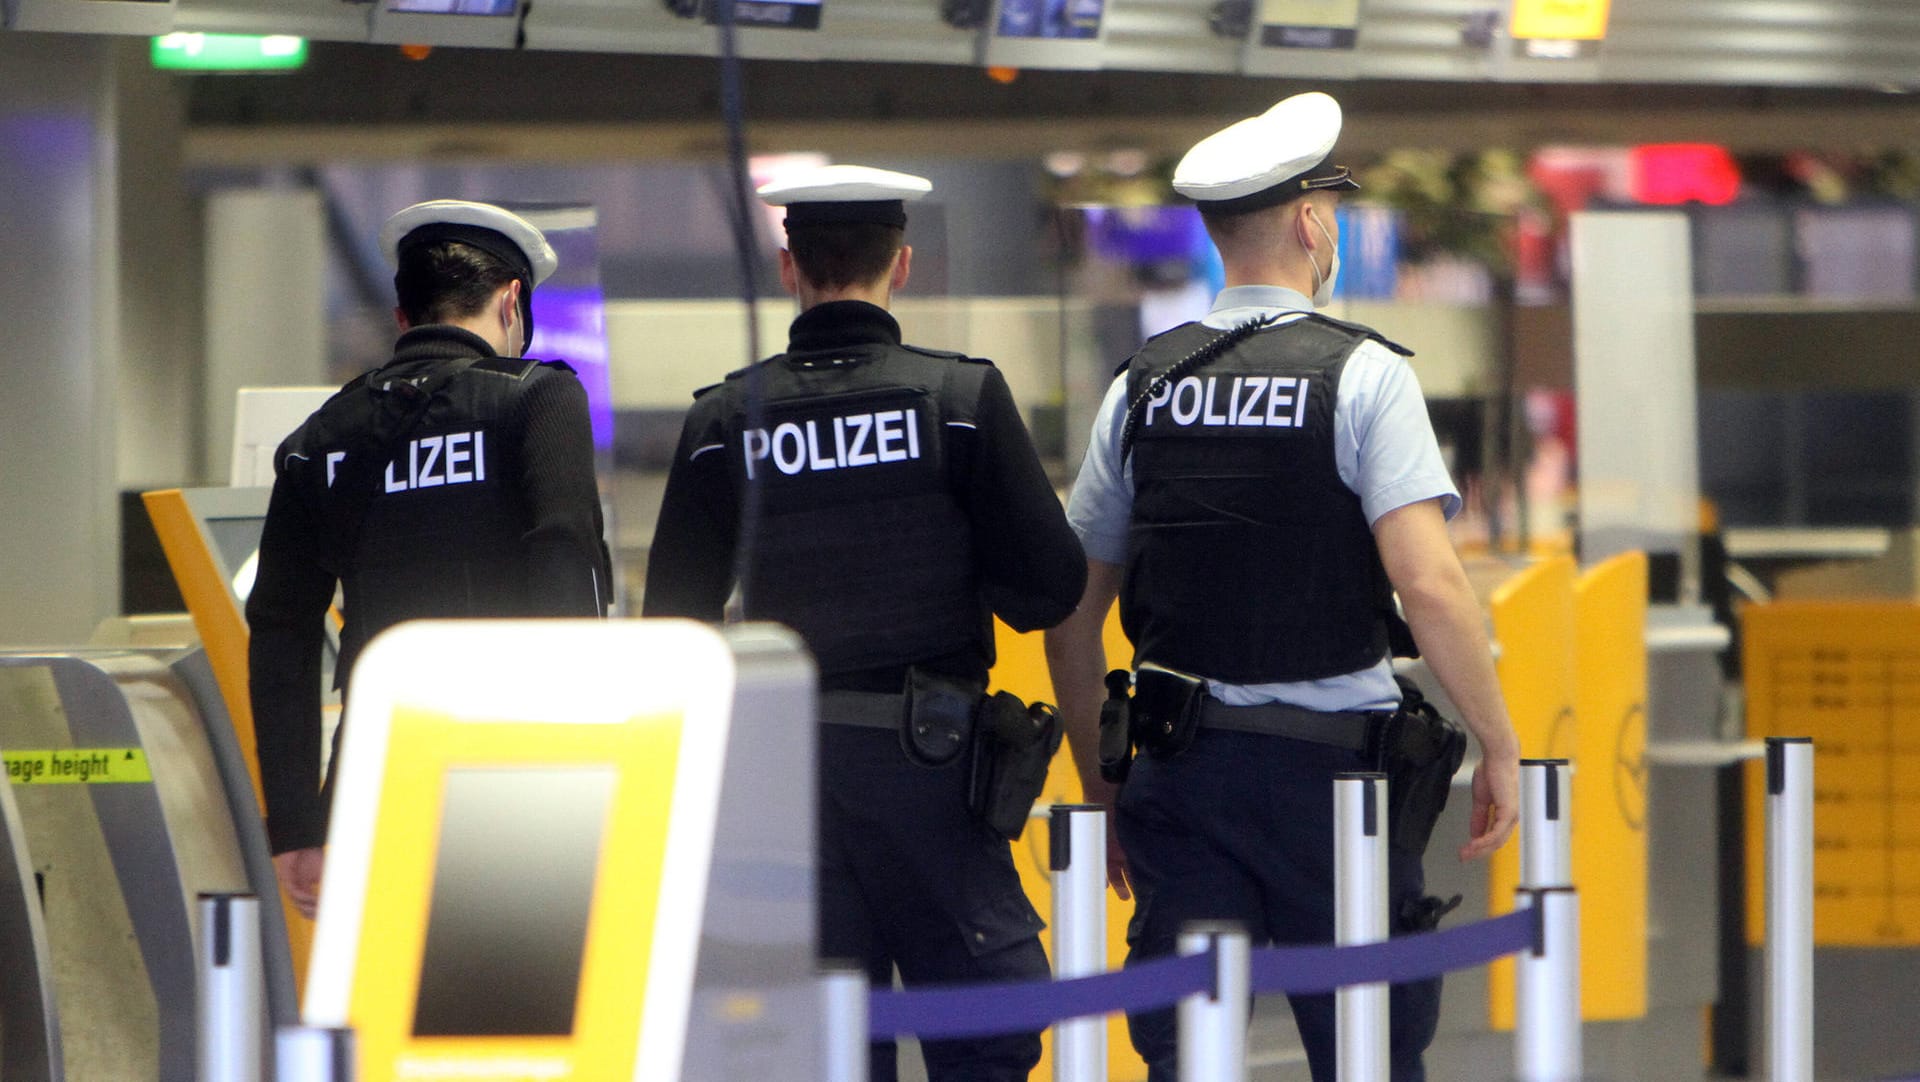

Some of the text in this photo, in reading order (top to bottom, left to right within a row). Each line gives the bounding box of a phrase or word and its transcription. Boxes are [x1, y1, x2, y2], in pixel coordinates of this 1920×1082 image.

[1145, 376, 1309, 427] POLIZEI
[326, 431, 485, 494] LIZEI
[743, 409, 920, 480] POLIZEI
[51, 753, 109, 781] height
